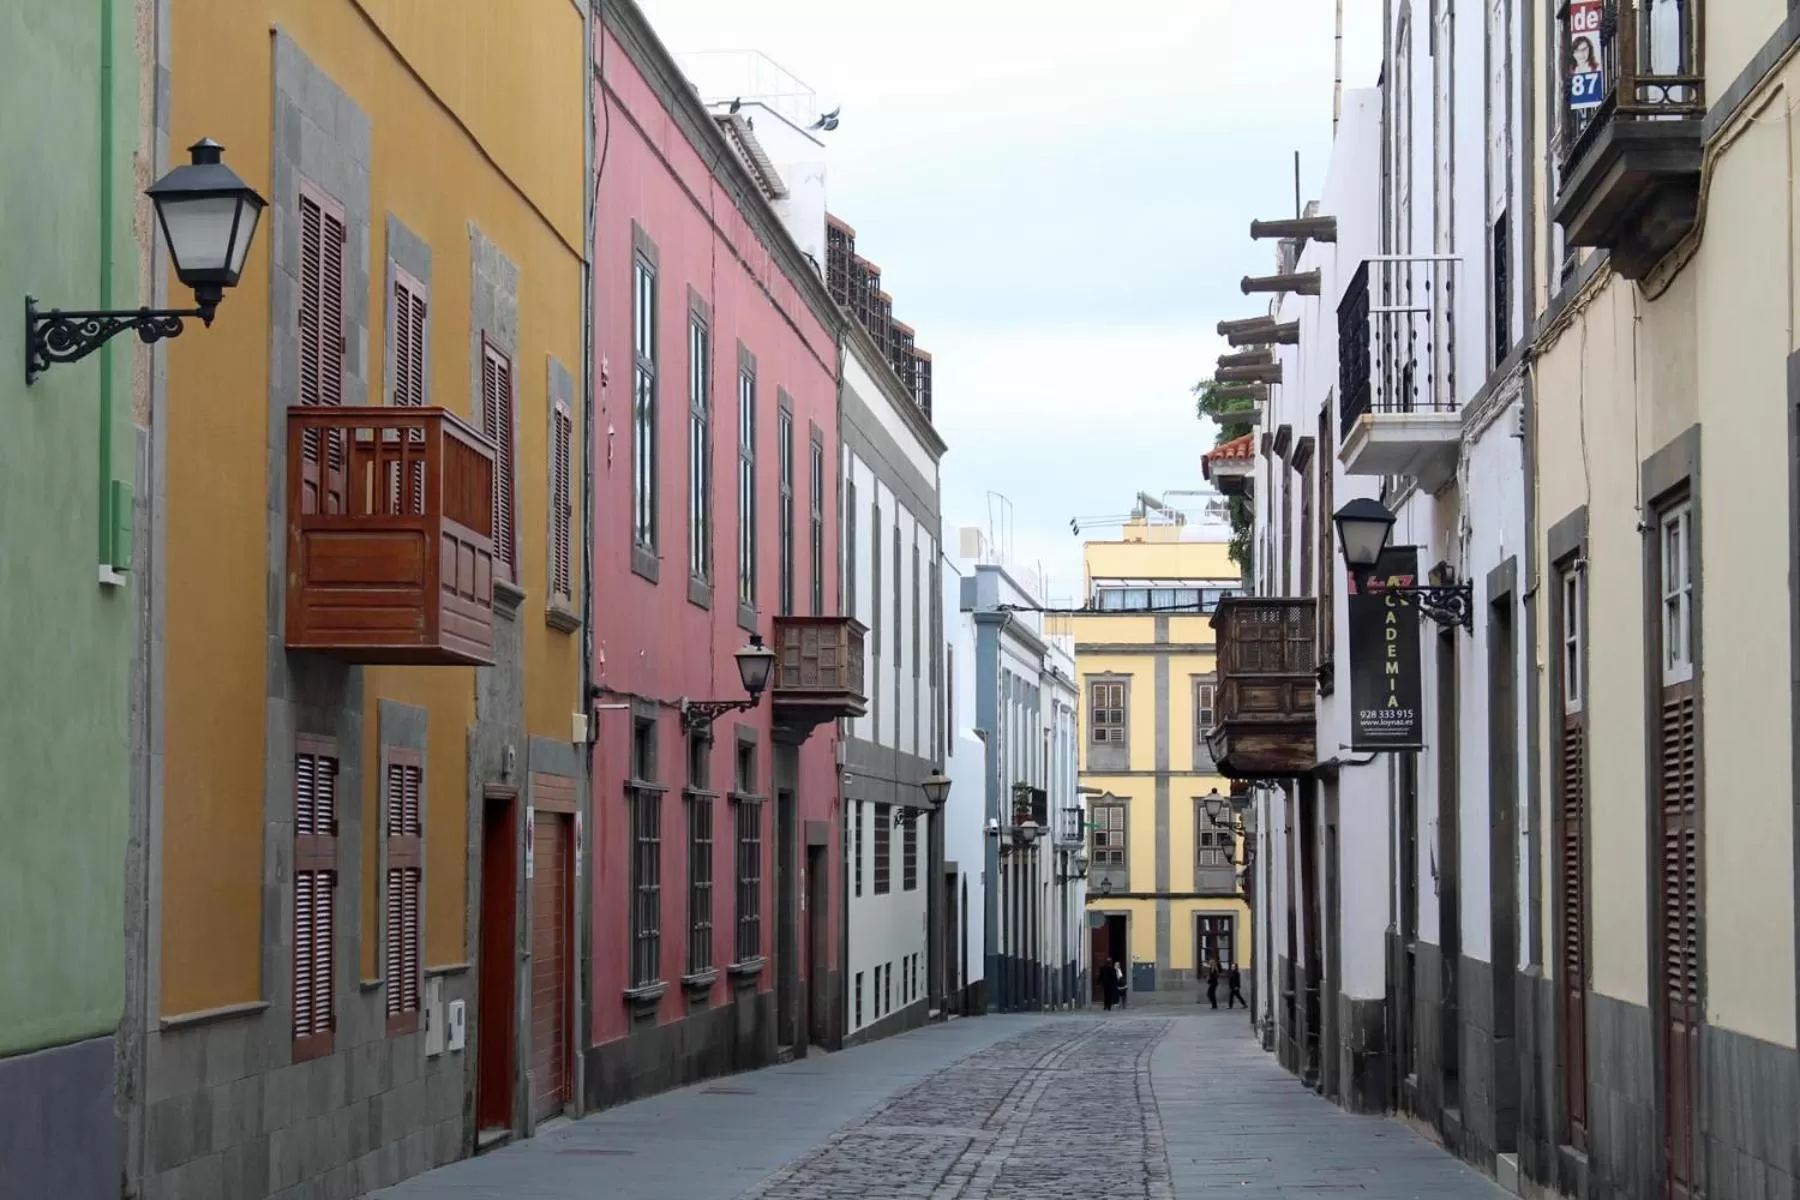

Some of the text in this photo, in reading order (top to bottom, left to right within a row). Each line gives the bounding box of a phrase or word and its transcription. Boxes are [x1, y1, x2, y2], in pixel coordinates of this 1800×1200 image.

[1571, 6, 1599, 31] de
[1571, 73, 1599, 96] 87
[1385, 575, 1400, 708] ACADEMIA
[1360, 709, 1414, 719] 928 333 915
